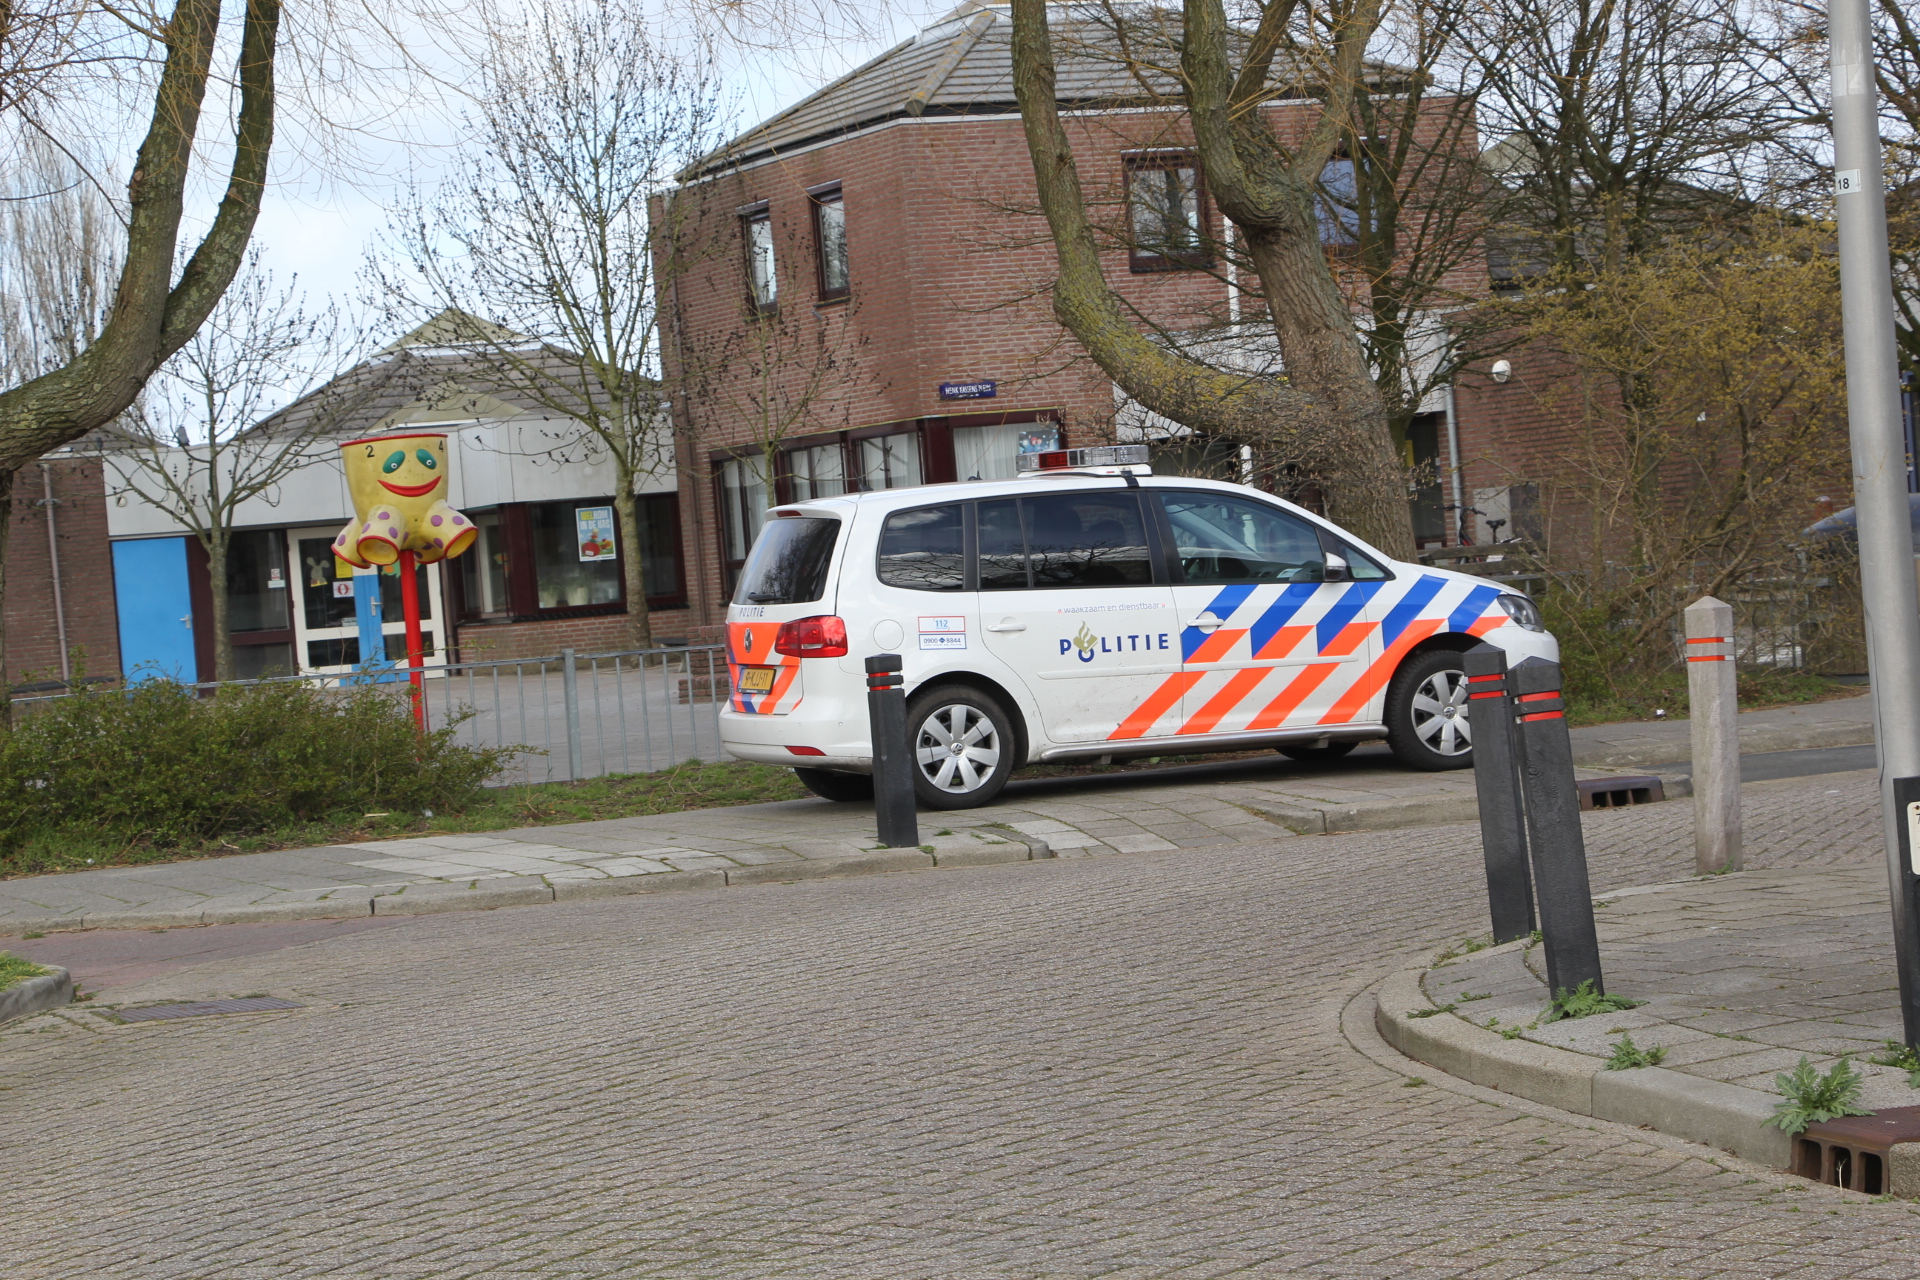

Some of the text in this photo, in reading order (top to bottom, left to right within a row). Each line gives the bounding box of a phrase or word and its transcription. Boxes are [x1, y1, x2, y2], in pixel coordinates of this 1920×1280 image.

[1838, 177, 1850, 190] 18
[945, 386, 959, 394] HENK
[365, 445, 375, 458] 2
[438, 440, 444, 452] 4
[580, 510, 608, 520] WELKOM
[588, 520, 596, 529] DE
[739, 606, 765, 617] POLITIE
[1064, 604, 1106, 614] waakzaam
[1107, 604, 1117, 612] en
[1119, 602, 1160, 611] dienstbaar
